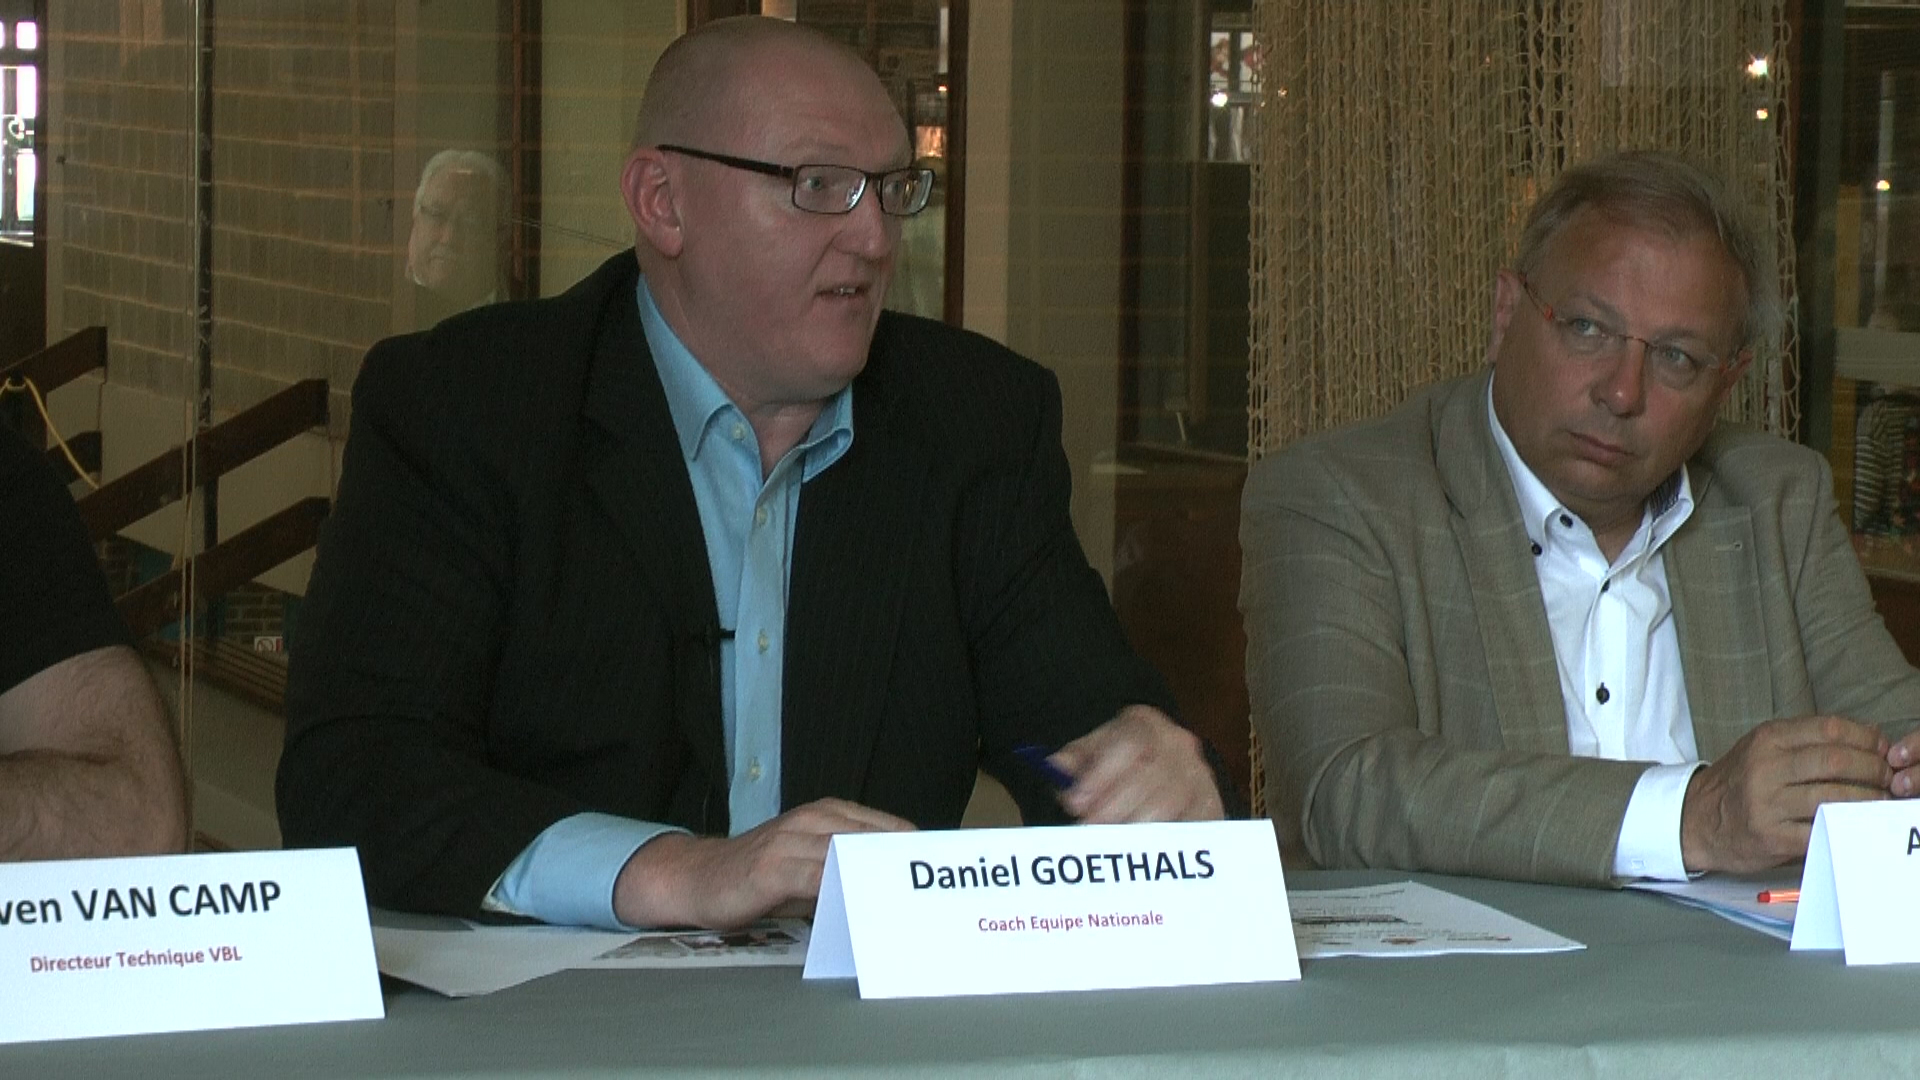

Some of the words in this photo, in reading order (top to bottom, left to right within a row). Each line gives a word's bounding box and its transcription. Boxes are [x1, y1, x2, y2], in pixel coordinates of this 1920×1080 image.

[910, 855, 1020, 890] Daniel
[1031, 850, 1214, 885] GOETHALS
[71, 887, 157, 921] VAN
[169, 880, 281, 917] CAMP
[978, 916, 1025, 932] Coach
[1031, 915, 1083, 933] Equipe
[1088, 910, 1163, 927] Nationale
[30, 956, 112, 973] Directeur
[116, 949, 204, 967] Technique
[209, 946, 242, 962] VBL
